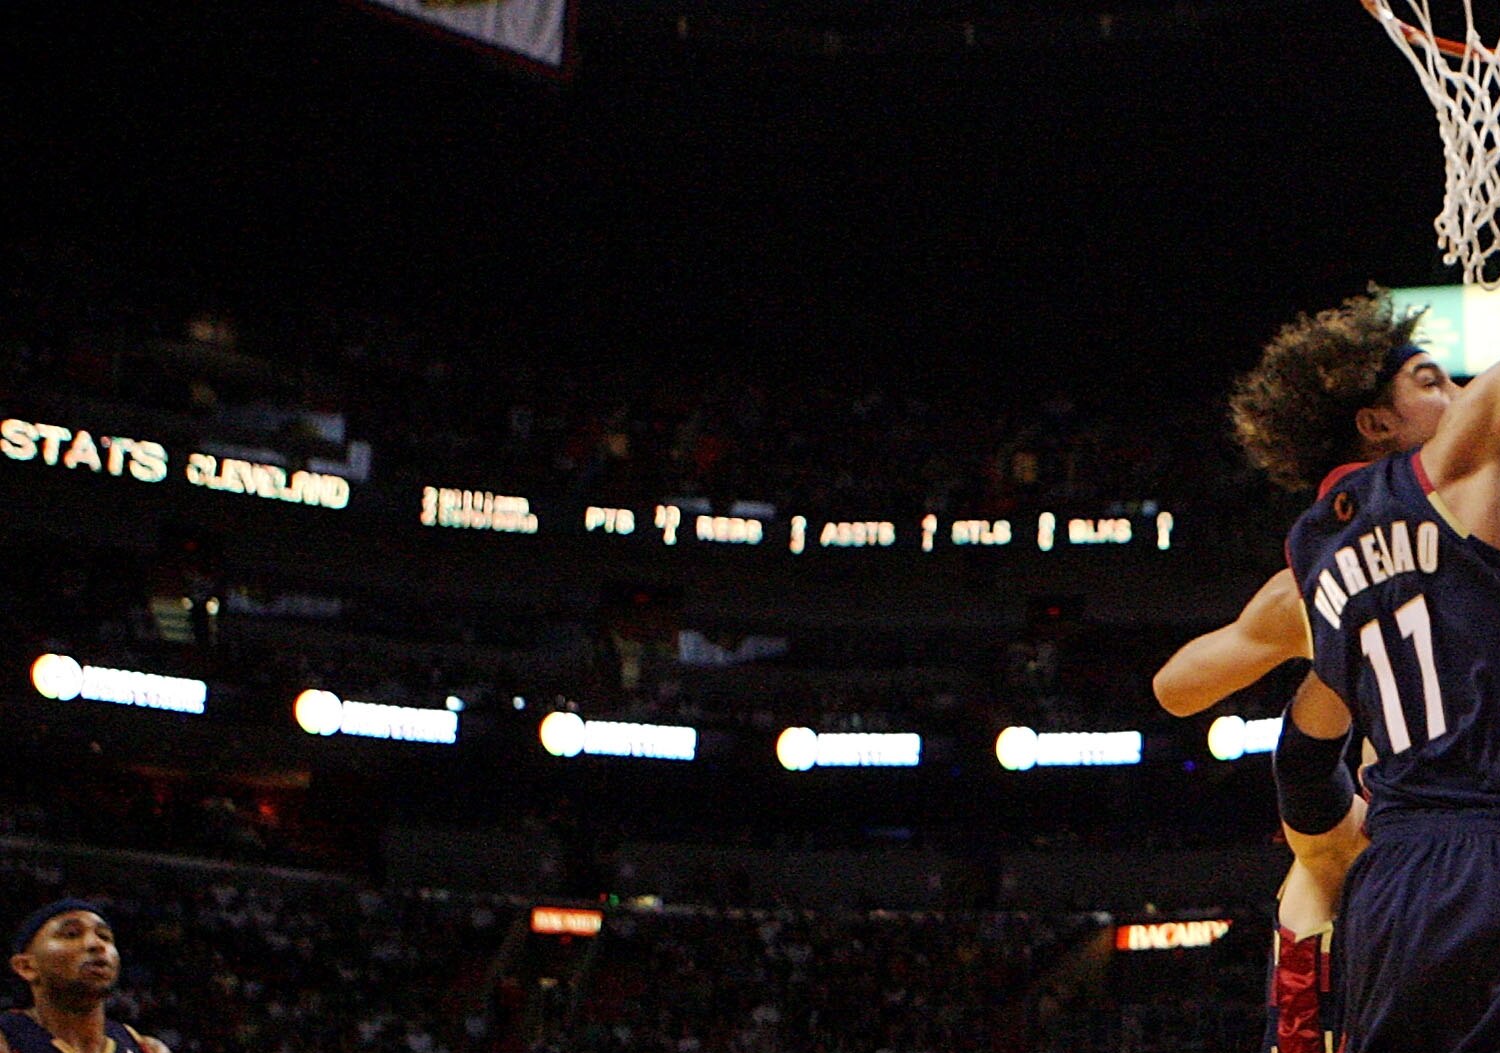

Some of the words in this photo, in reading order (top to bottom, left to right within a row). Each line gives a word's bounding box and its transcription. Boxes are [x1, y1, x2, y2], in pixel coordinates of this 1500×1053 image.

[0, 419, 168, 482] STATS
[187, 454, 350, 509] CLEVELAND
[1360, 594, 1447, 755] 11
